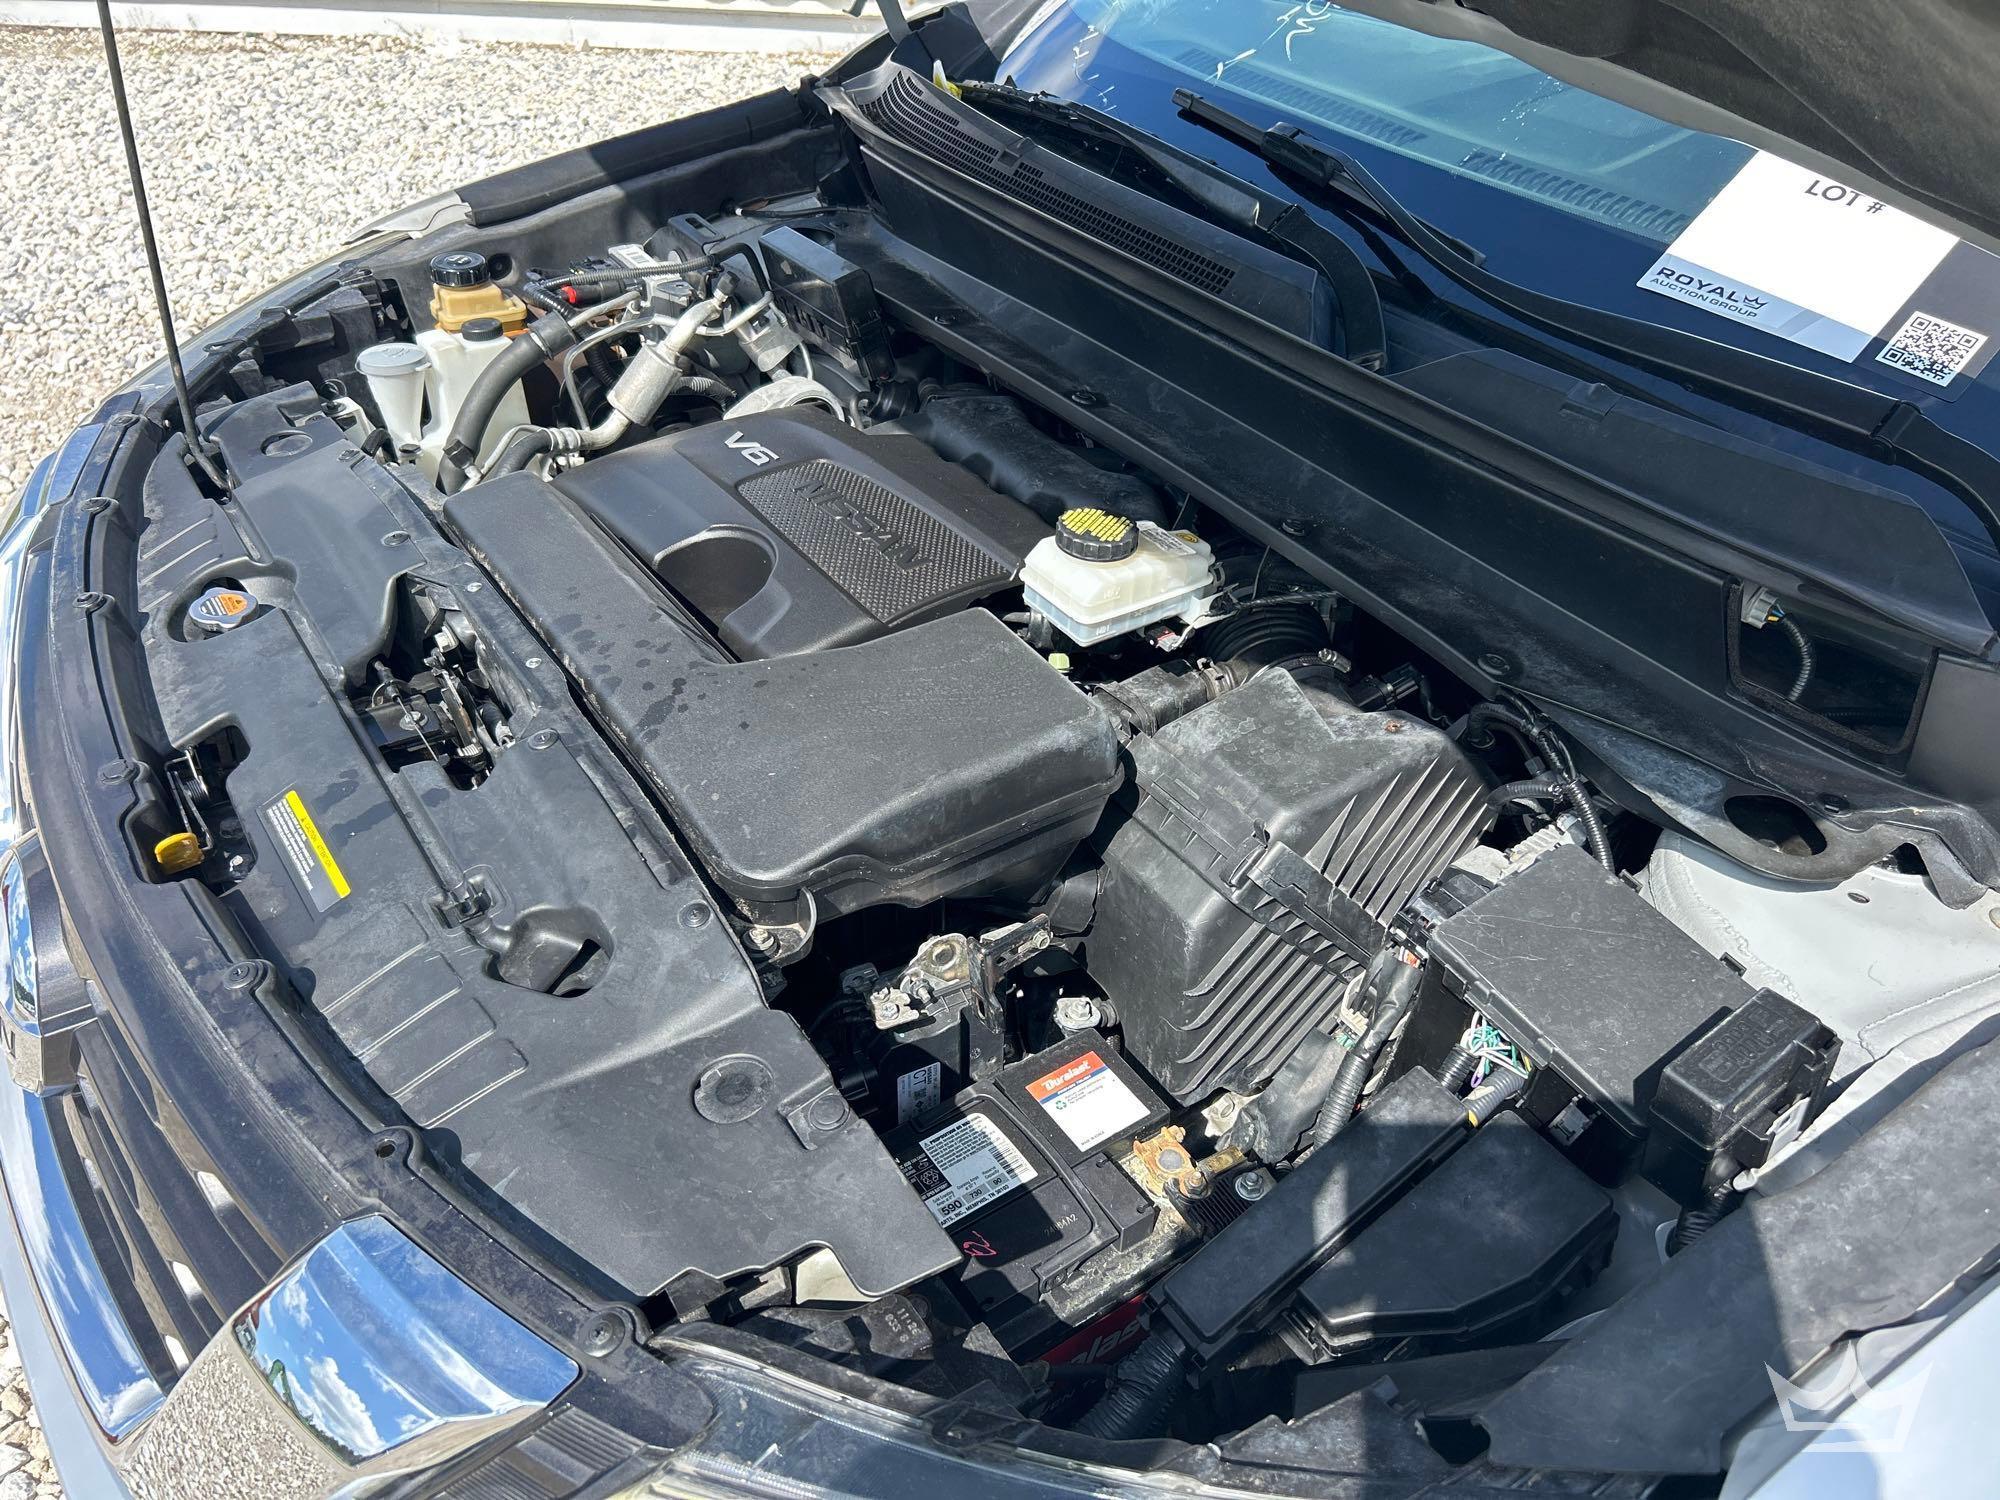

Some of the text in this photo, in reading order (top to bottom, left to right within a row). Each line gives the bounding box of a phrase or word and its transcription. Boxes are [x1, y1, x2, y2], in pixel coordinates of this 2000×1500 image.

[1804, 180, 1887, 214] LOT #
[1649, 277, 1758, 318] AUCTION GROUP
[1656, 266, 1740, 303] ROYAL
[724, 430, 780, 466] V6
[792, 478, 933, 571] NISSAN
[913, 1070, 927, 1085] CT
[1041, 1060, 1091, 1091] Duralast
[941, 1200, 963, 1215] 590
[969, 1190, 982, 1198] 730
[940, 1216, 955, 1225] ARTS,
[966, 1197, 989, 1210] MEMPHIS,
